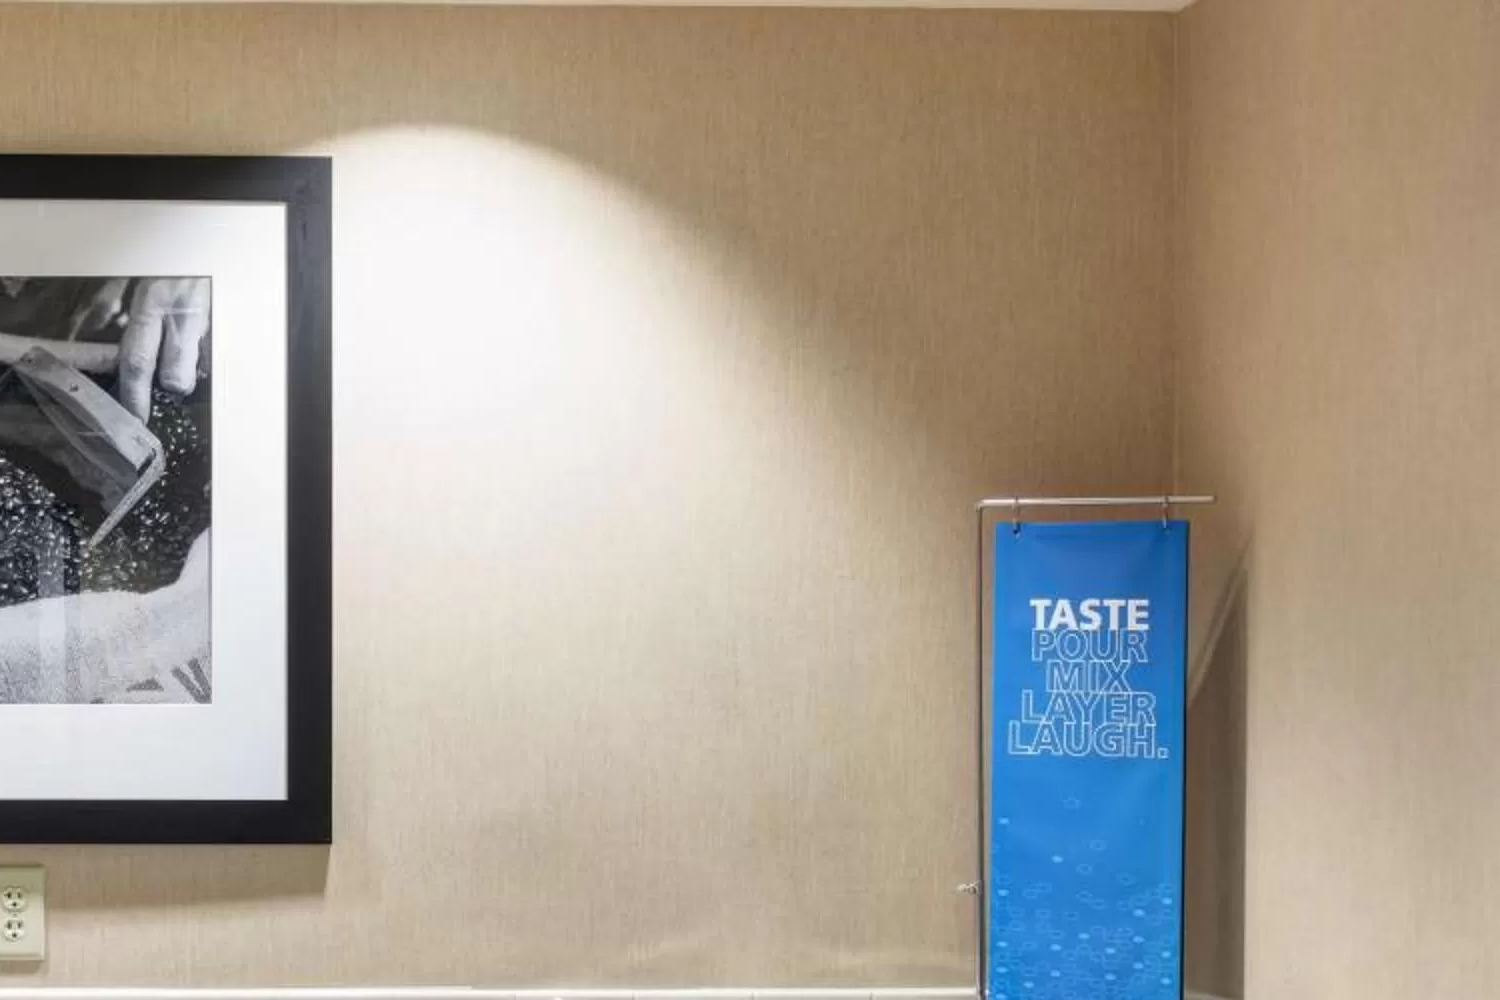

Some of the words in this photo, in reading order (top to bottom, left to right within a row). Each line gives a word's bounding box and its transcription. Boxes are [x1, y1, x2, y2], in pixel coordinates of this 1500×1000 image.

[1029, 599, 1150, 632] TASTE
[1031, 628, 1149, 663] POUR
[1046, 659, 1133, 693] MIX
[1021, 689, 1157, 726] LAYER
[1007, 720, 1170, 759] LAUGH.
